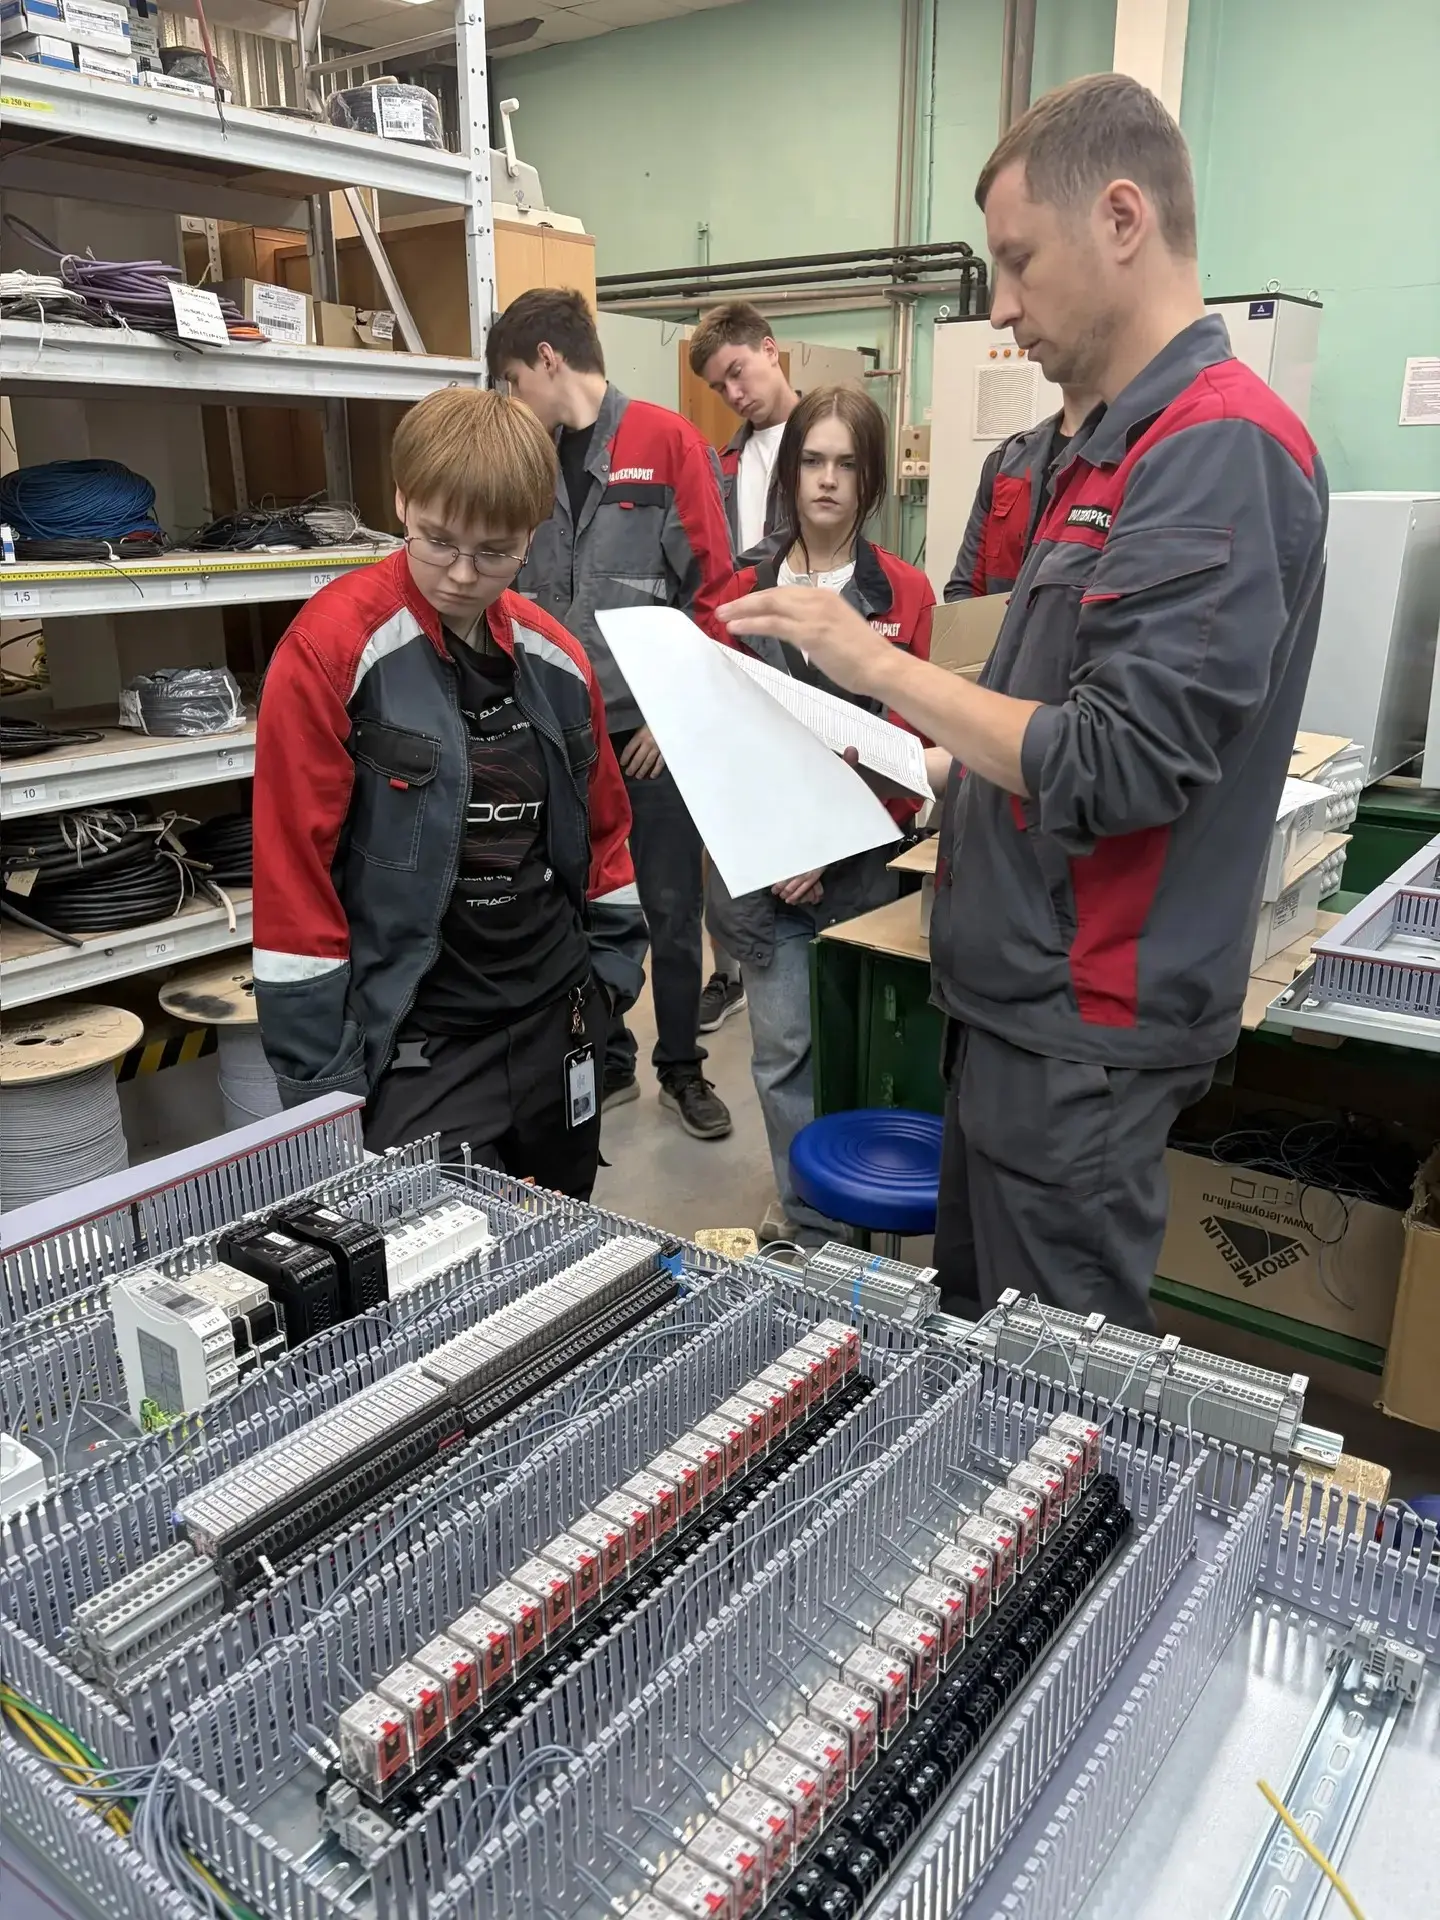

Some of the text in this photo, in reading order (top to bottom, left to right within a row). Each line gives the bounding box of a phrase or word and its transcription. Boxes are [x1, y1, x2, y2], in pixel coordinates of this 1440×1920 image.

[184, 582, 189, 591] 1
[314, 575, 332, 585] 0,75
[13, 590, 31, 604] 1,5
[226, 757, 234, 767] 6
[22, 787, 37, 800] 10
[466, 894, 518, 907] TRACK
[155, 943, 166, 953] 70
[1202, 1193, 1314, 1232] www.leroymerlin.ru
[1199, 1216, 1310, 1288] LEROY MERLIN
